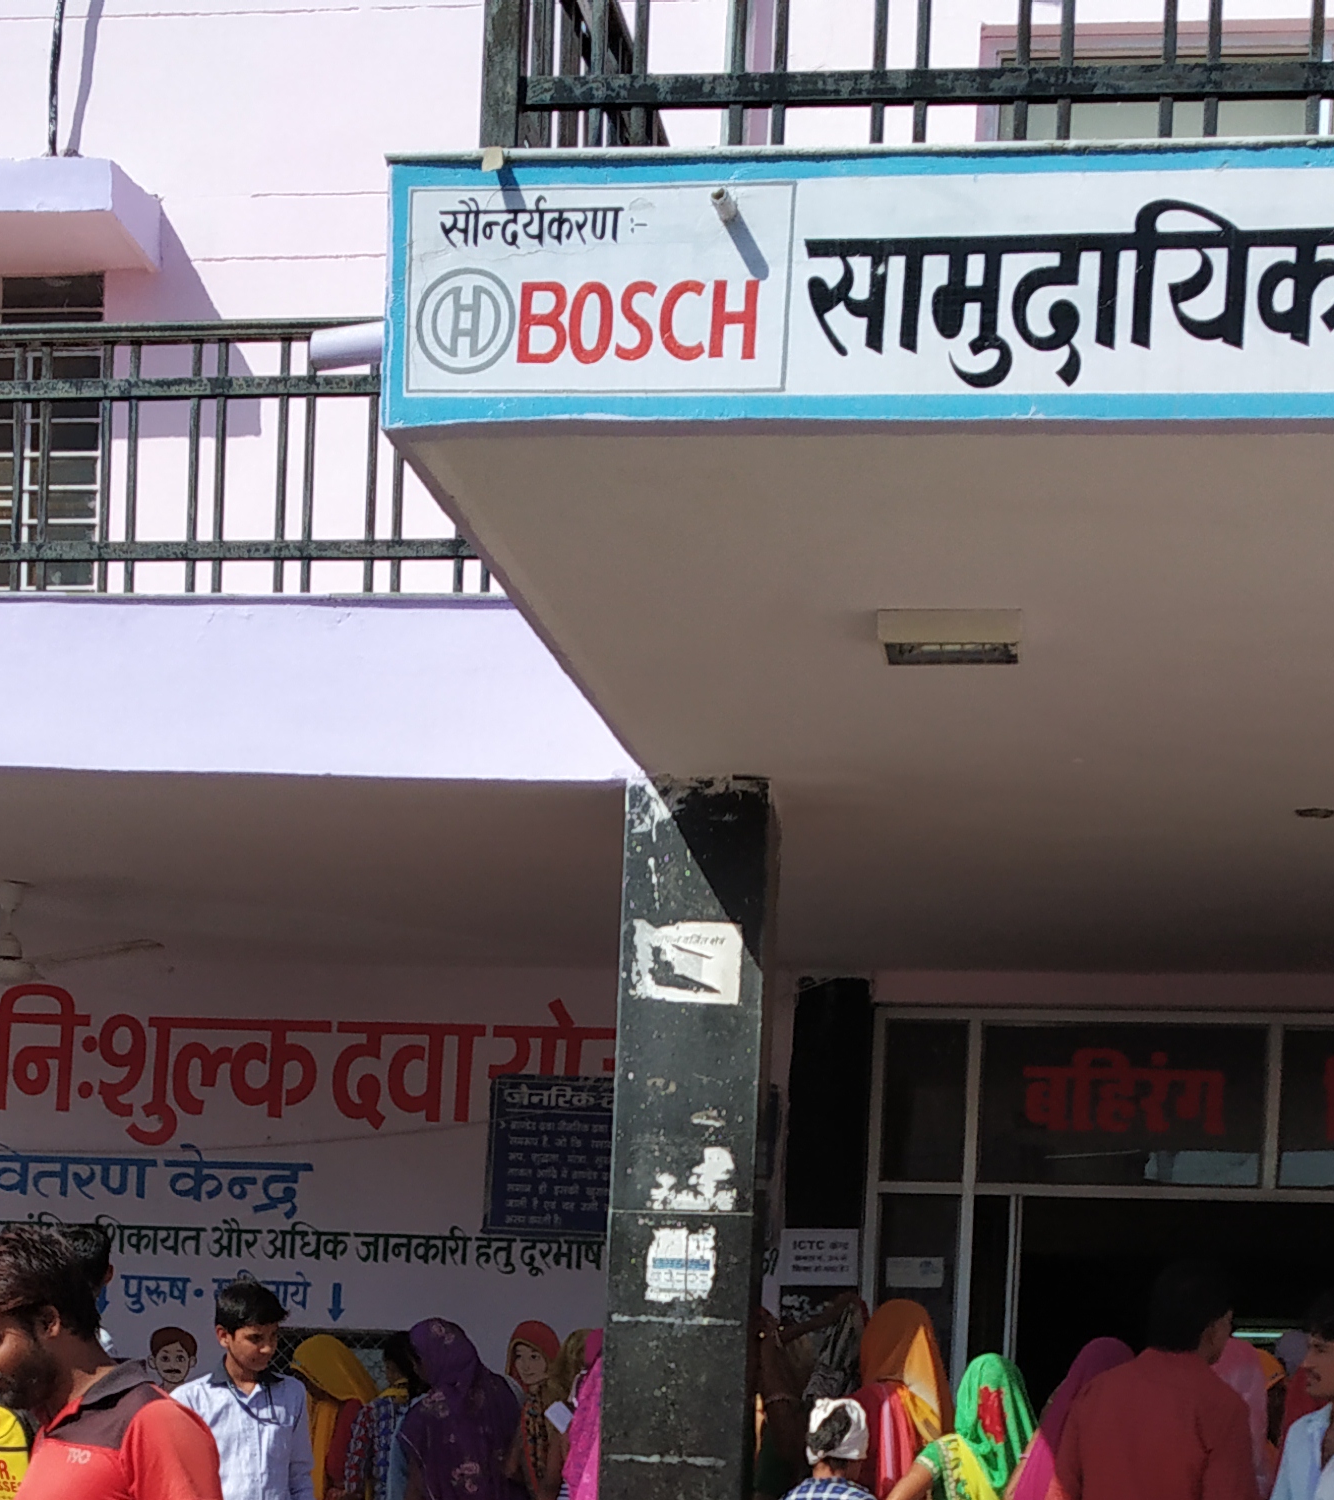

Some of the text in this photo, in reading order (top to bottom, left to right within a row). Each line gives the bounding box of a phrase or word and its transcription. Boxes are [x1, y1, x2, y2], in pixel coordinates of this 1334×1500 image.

[516, 279, 761, 365] BOSCH
[336, 1019, 486, 1130] दवा
[1022, 1047, 1225, 1135] बहिरंग
[162, 1143, 314, 1220] केन्द्र
[208, 1217, 263, 1258] और
[262, 1221, 351, 1261] अधिक
[353, 1225, 472, 1266] जानकारी
[519, 1238, 606, 1277] दूरभाष
[793, 1240, 825, 1250] ICTC
